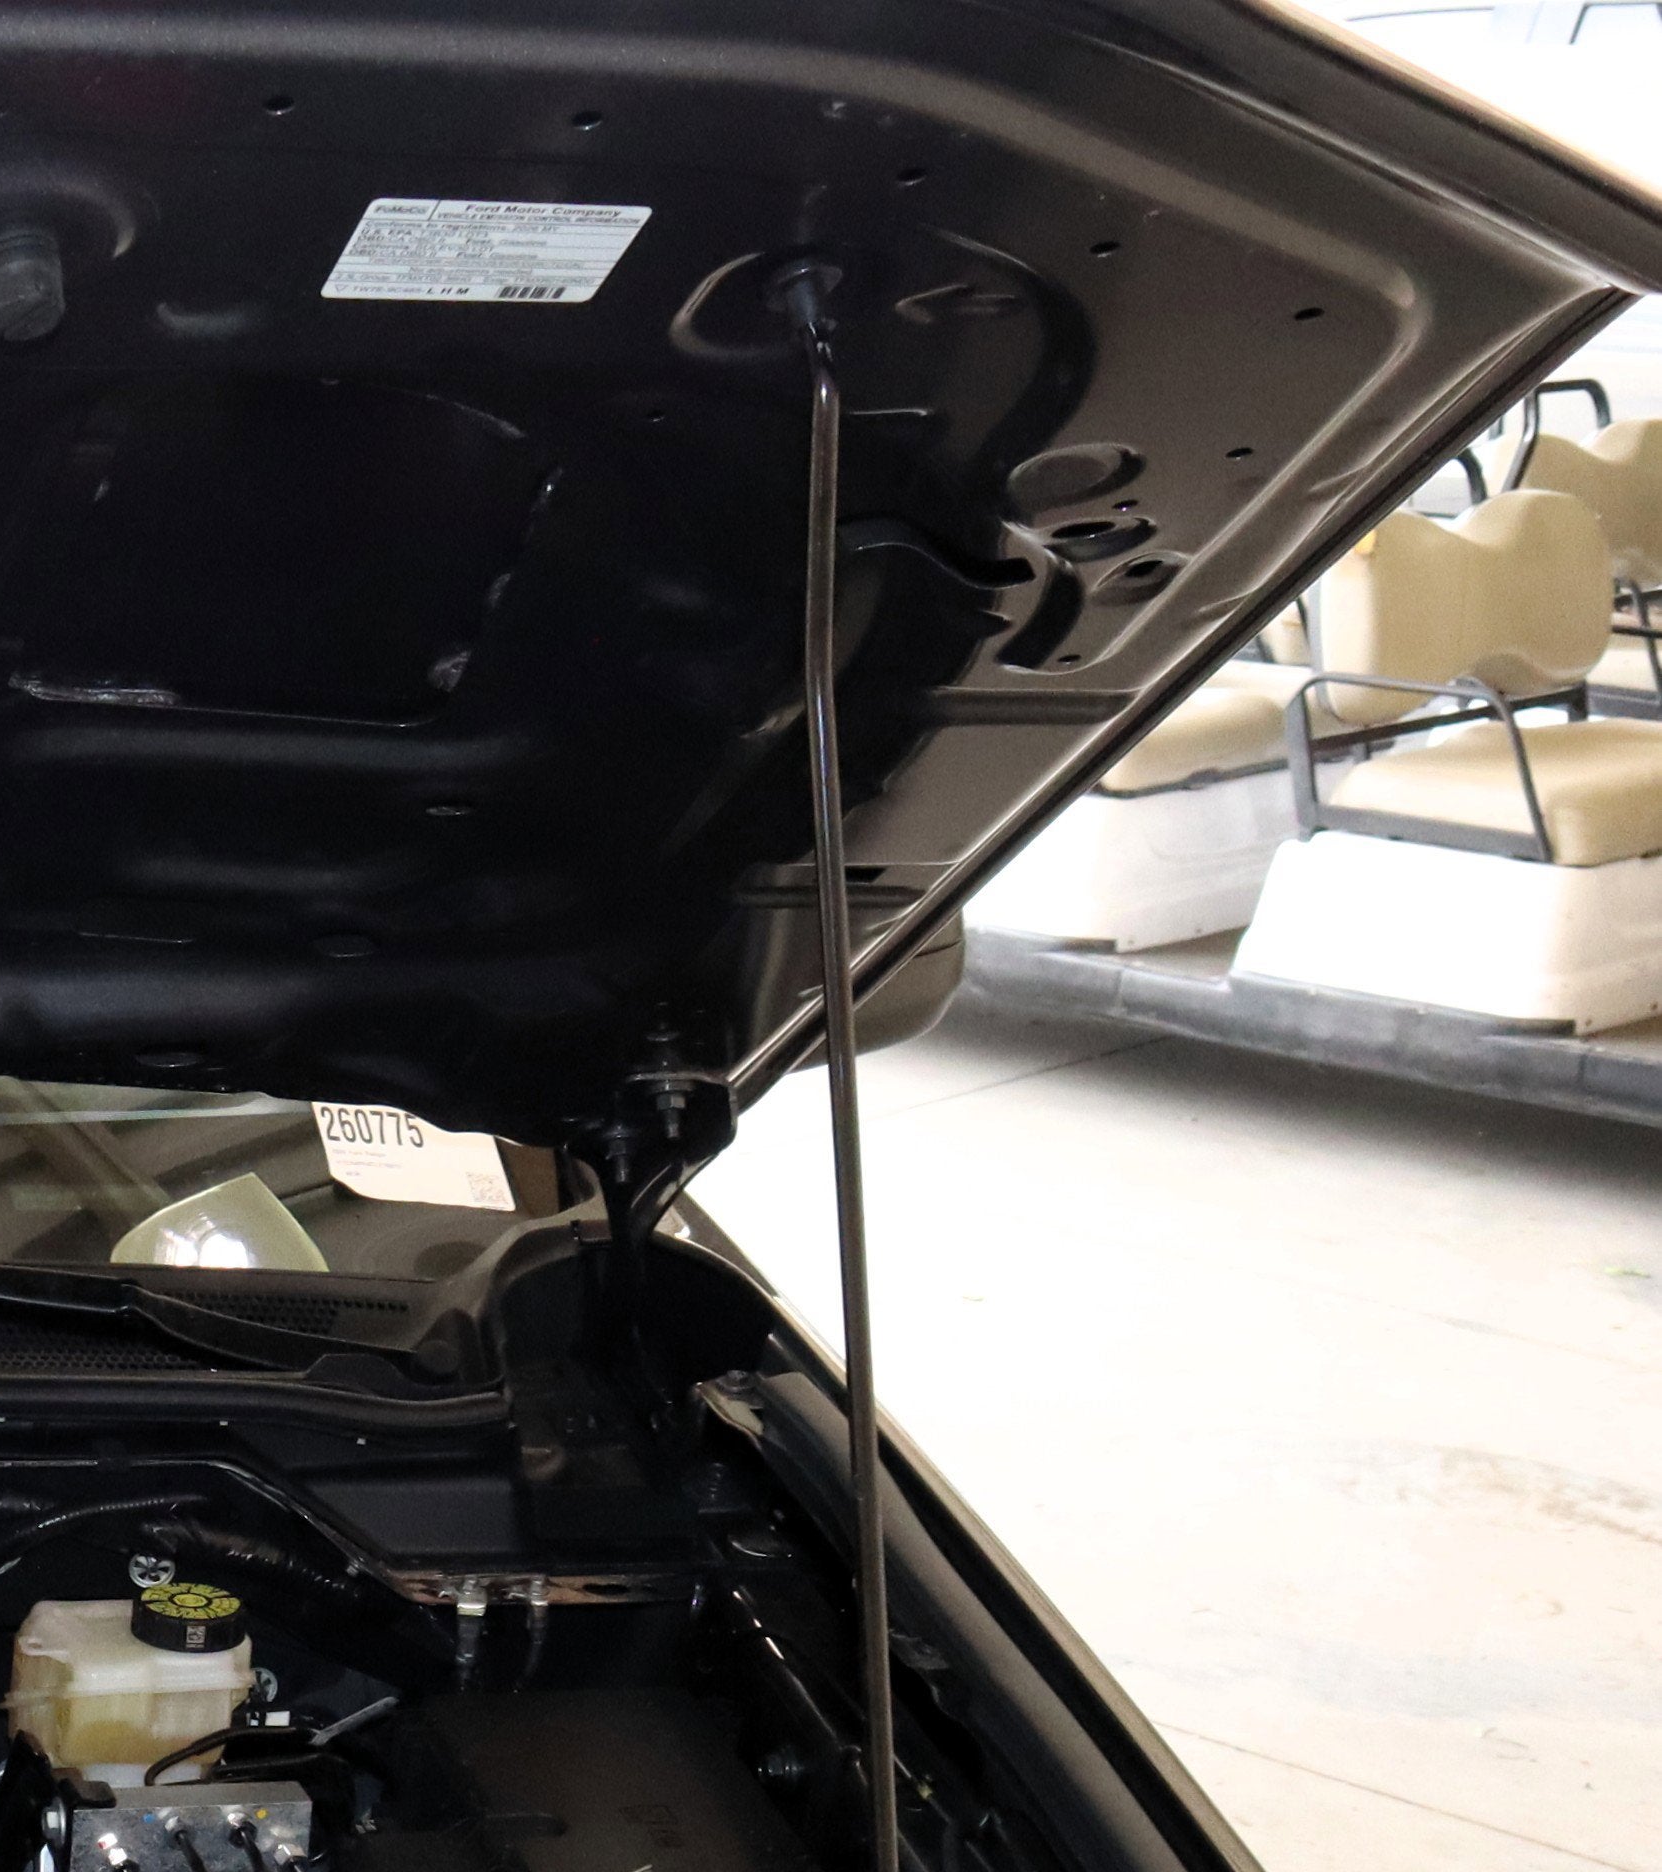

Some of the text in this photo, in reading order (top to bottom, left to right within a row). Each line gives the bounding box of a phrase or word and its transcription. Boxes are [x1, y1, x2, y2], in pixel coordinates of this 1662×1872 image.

[372, 205, 429, 215] FoMoCo
[463, 204, 623, 217] Ford Motor Company
[436, 212, 477, 220] VEHICLE
[573, 216, 641, 224] INFORMATION
[320, 1106, 424, 1148] 260775
